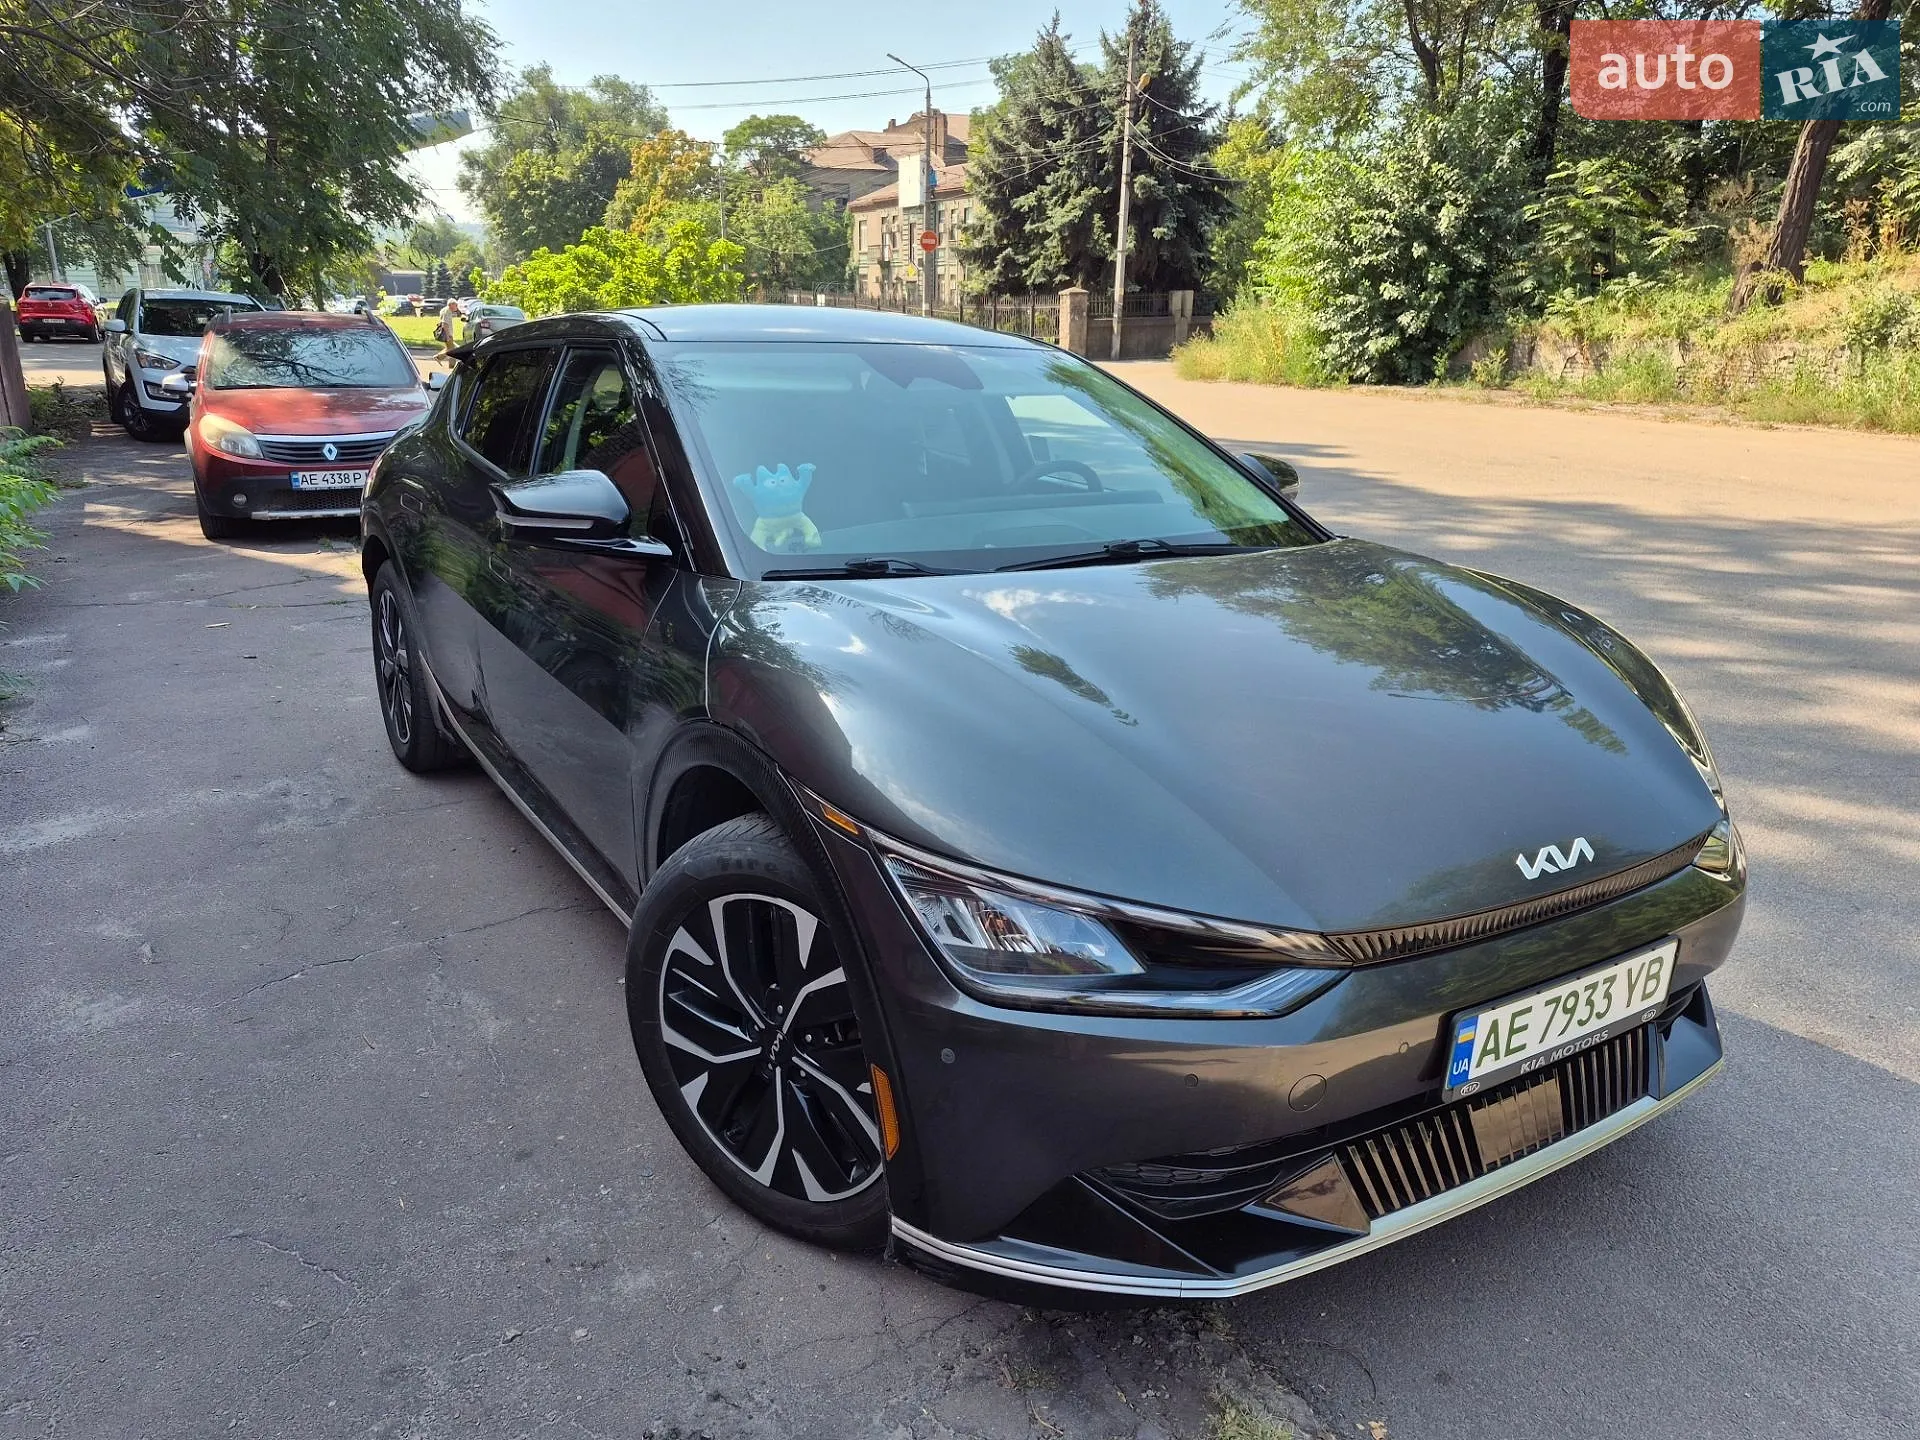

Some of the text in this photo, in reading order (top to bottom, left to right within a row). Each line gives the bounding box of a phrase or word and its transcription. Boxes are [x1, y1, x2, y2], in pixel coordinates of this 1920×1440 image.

[301, 473, 319, 485] AE
[322, 472, 351, 485] 4338
[1516, 837, 1595, 880] KIA
[1475, 956, 1665, 1069] AE 7933 YB
[1453, 1058, 1469, 1075] UA
[1520, 1030, 1609, 1075] KIA MOTORS
